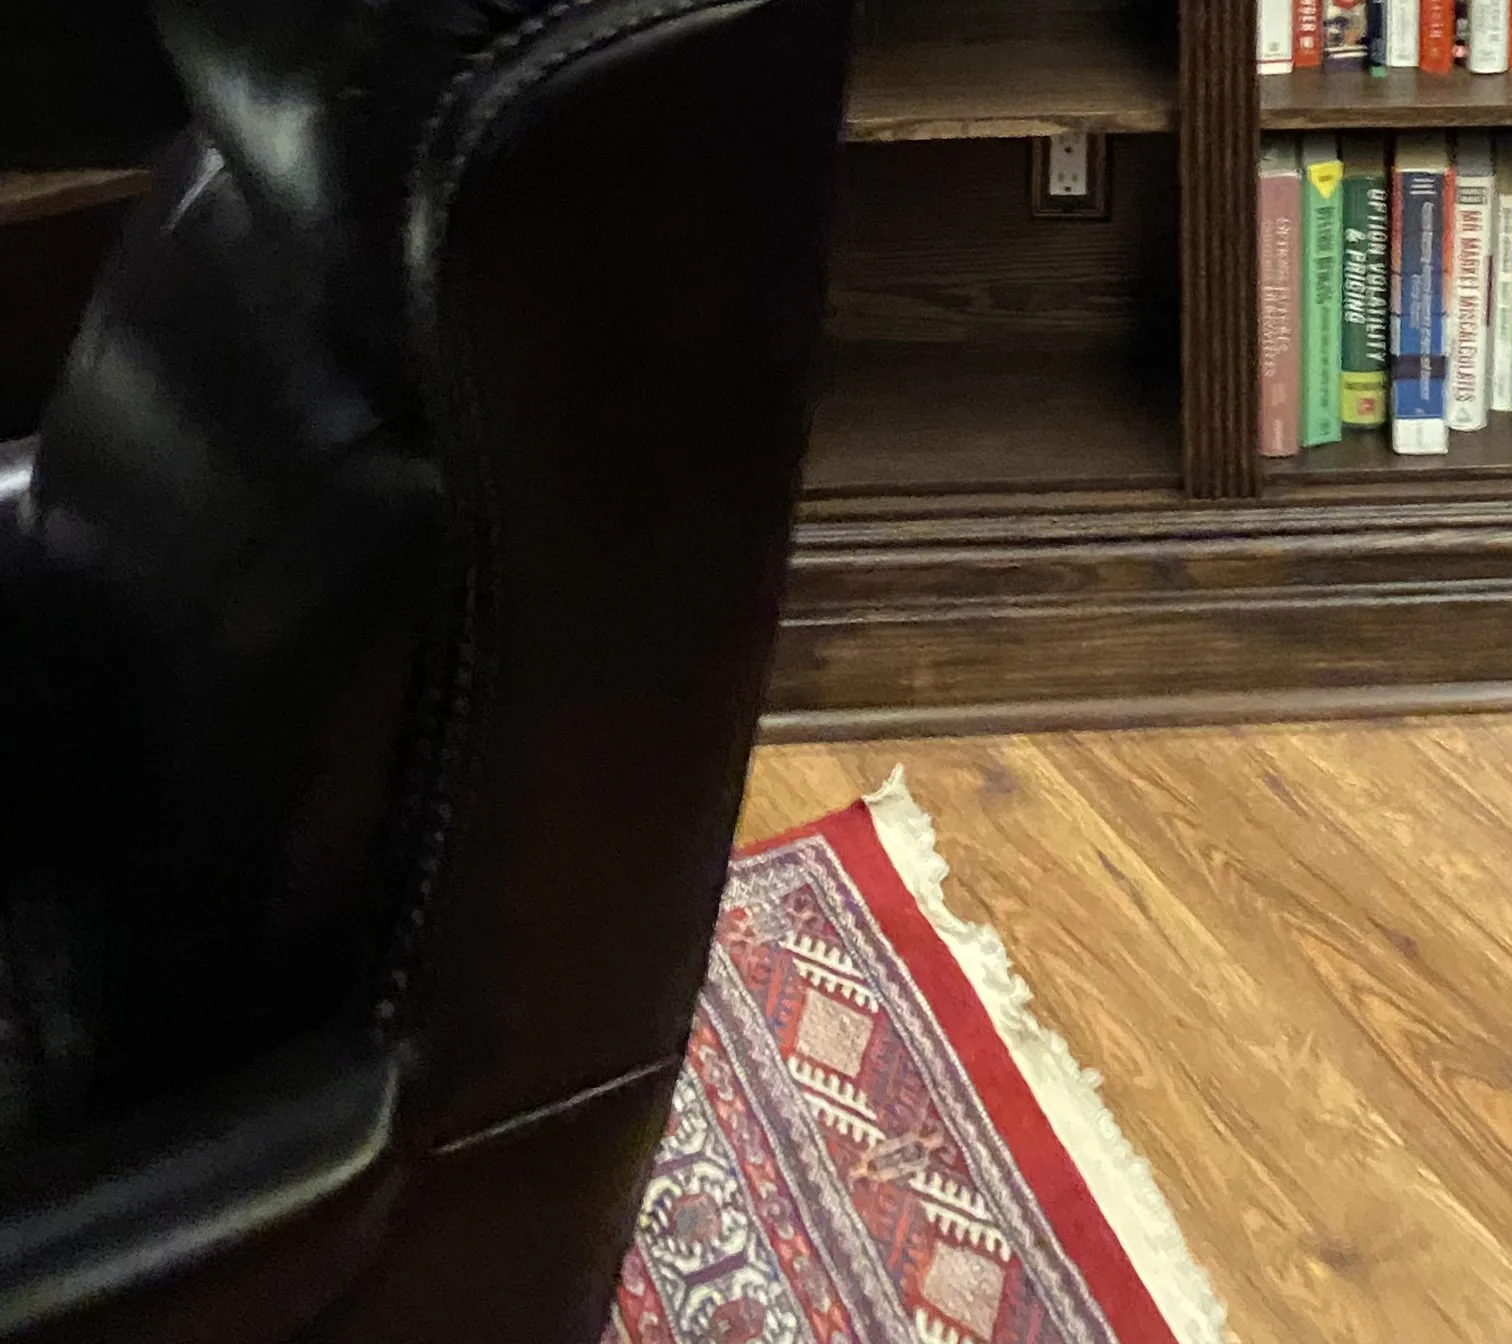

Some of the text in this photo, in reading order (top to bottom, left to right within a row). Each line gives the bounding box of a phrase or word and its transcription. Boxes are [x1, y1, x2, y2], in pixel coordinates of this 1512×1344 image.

[1345, 228, 1366, 325] & PRICING
[1366, 188, 1388, 362] OPTION VOLATILITY
[1458, 237, 1480, 290] MARKET
